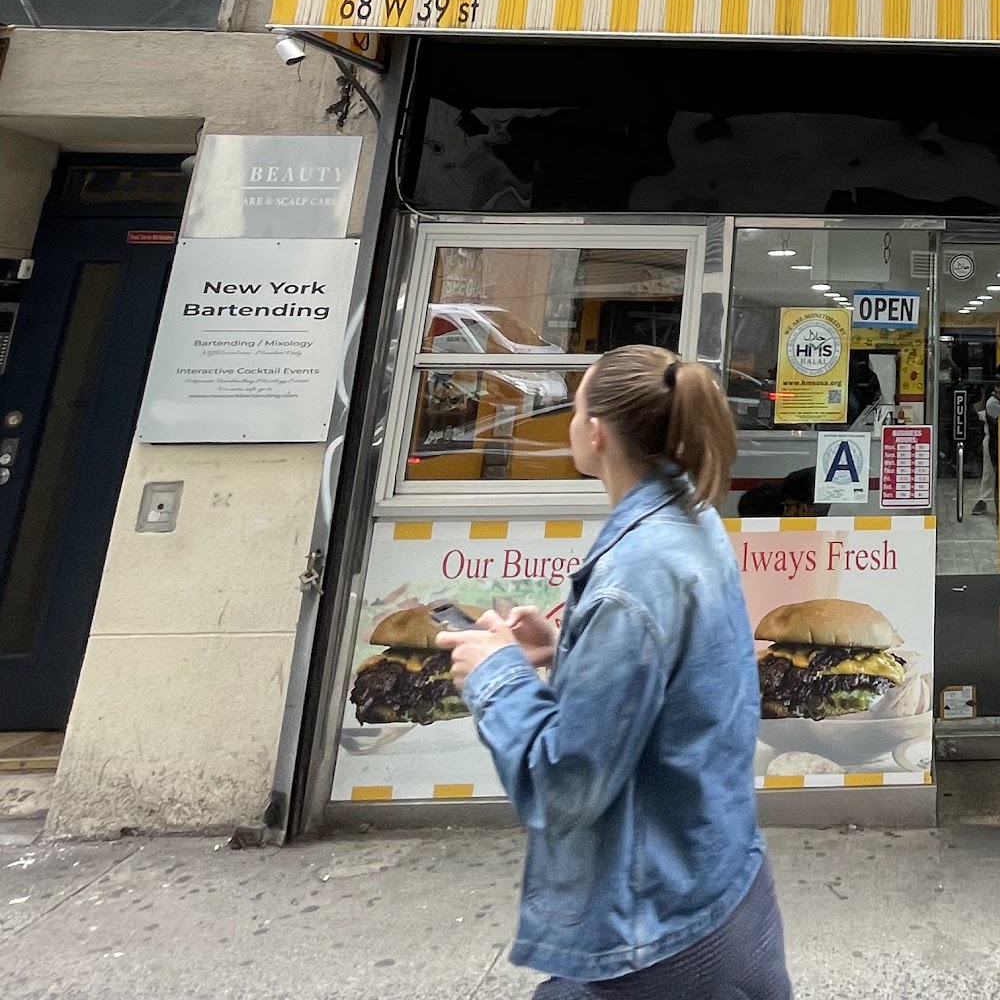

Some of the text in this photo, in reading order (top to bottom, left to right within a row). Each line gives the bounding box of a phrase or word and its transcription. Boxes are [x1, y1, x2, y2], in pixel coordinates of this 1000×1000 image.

[250, 166, 344, 182] BEAUTY
[275, 196, 309, 206] SCALP
[203, 281, 327, 295] New York
[182, 303, 330, 320] Bartending
[859, 296, 914, 322] OPEN
[194, 340, 314, 348] Bartending Mixology
[796, 344, 833, 357] HMS
[176, 367, 320, 375] Interactive Cocktail Events
[824, 441, 860, 483] A
[441, 548, 586, 587] Our Burge
[742, 540, 898, 582] lways Fresh
